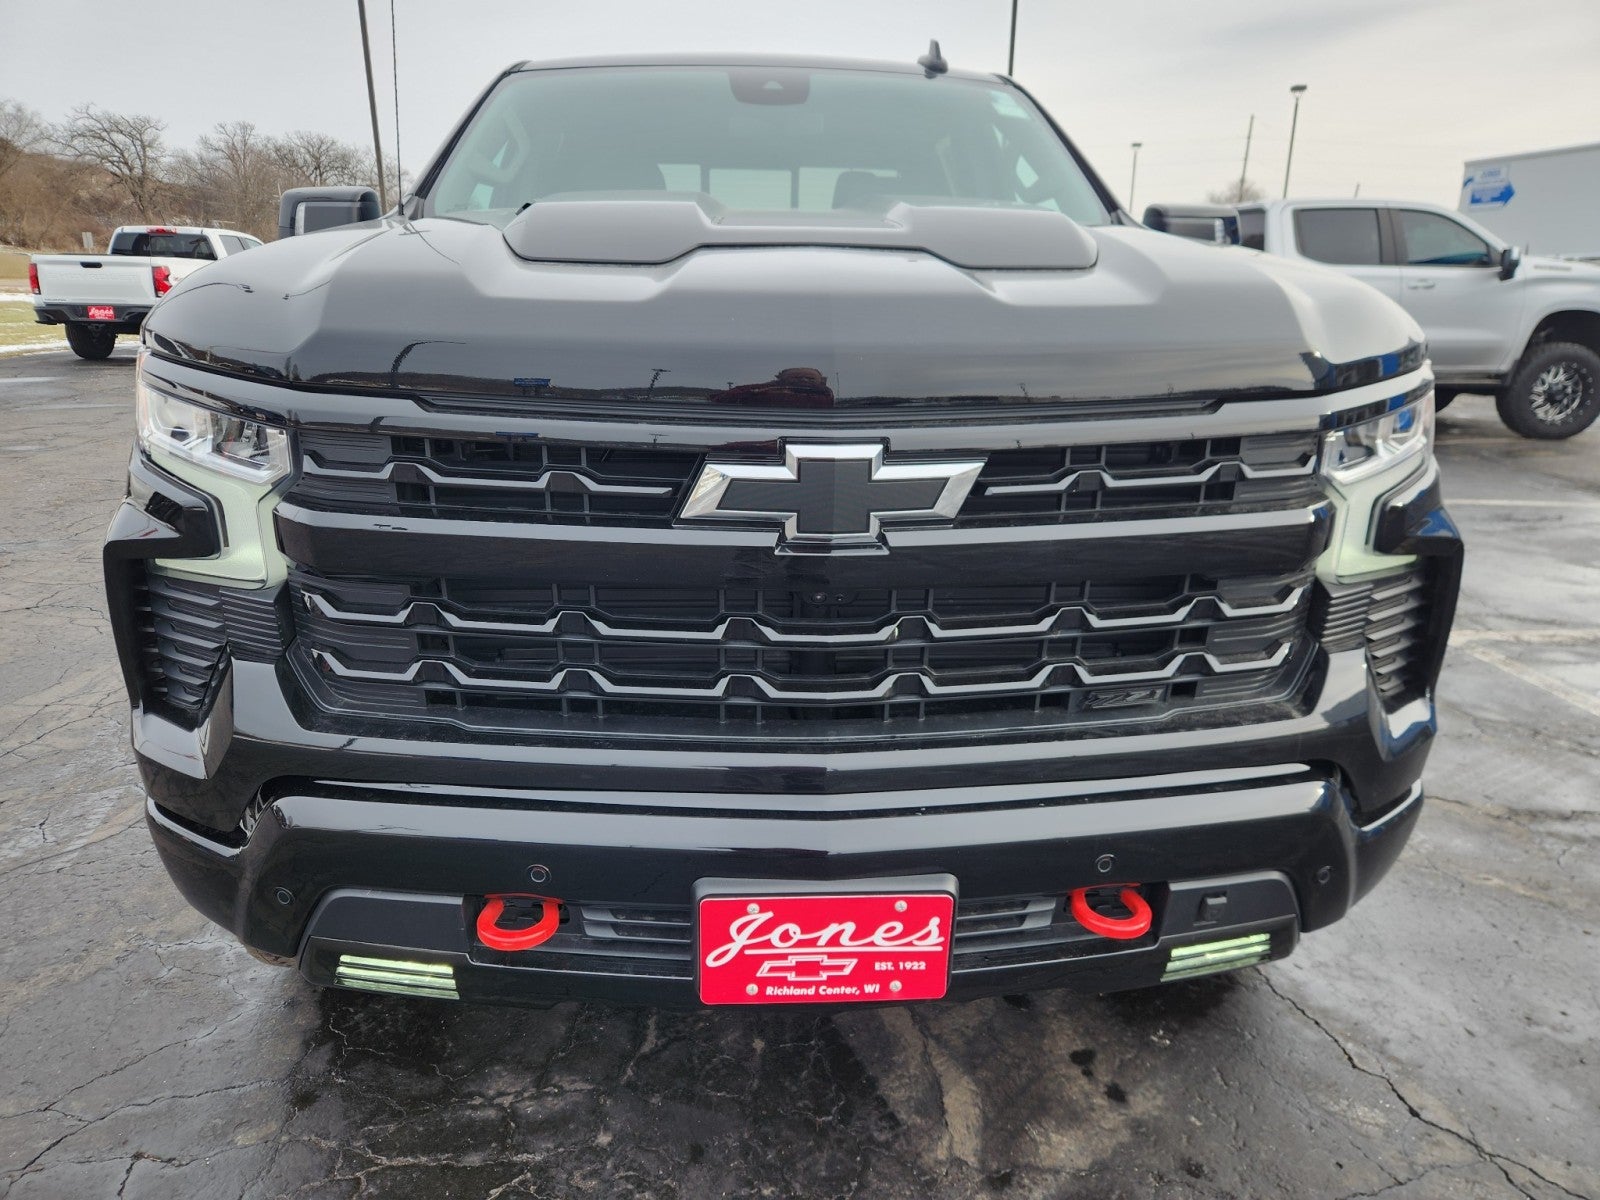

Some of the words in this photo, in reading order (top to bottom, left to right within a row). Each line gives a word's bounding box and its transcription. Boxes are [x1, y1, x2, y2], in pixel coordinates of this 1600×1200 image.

[706, 911, 945, 967] Jones
[874, 962, 895, 971] EST.
[898, 961, 926, 970] 1922
[765, 986, 816, 996] Richland
[818, 985, 861, 995] Center,
[863, 984, 880, 993] WI
